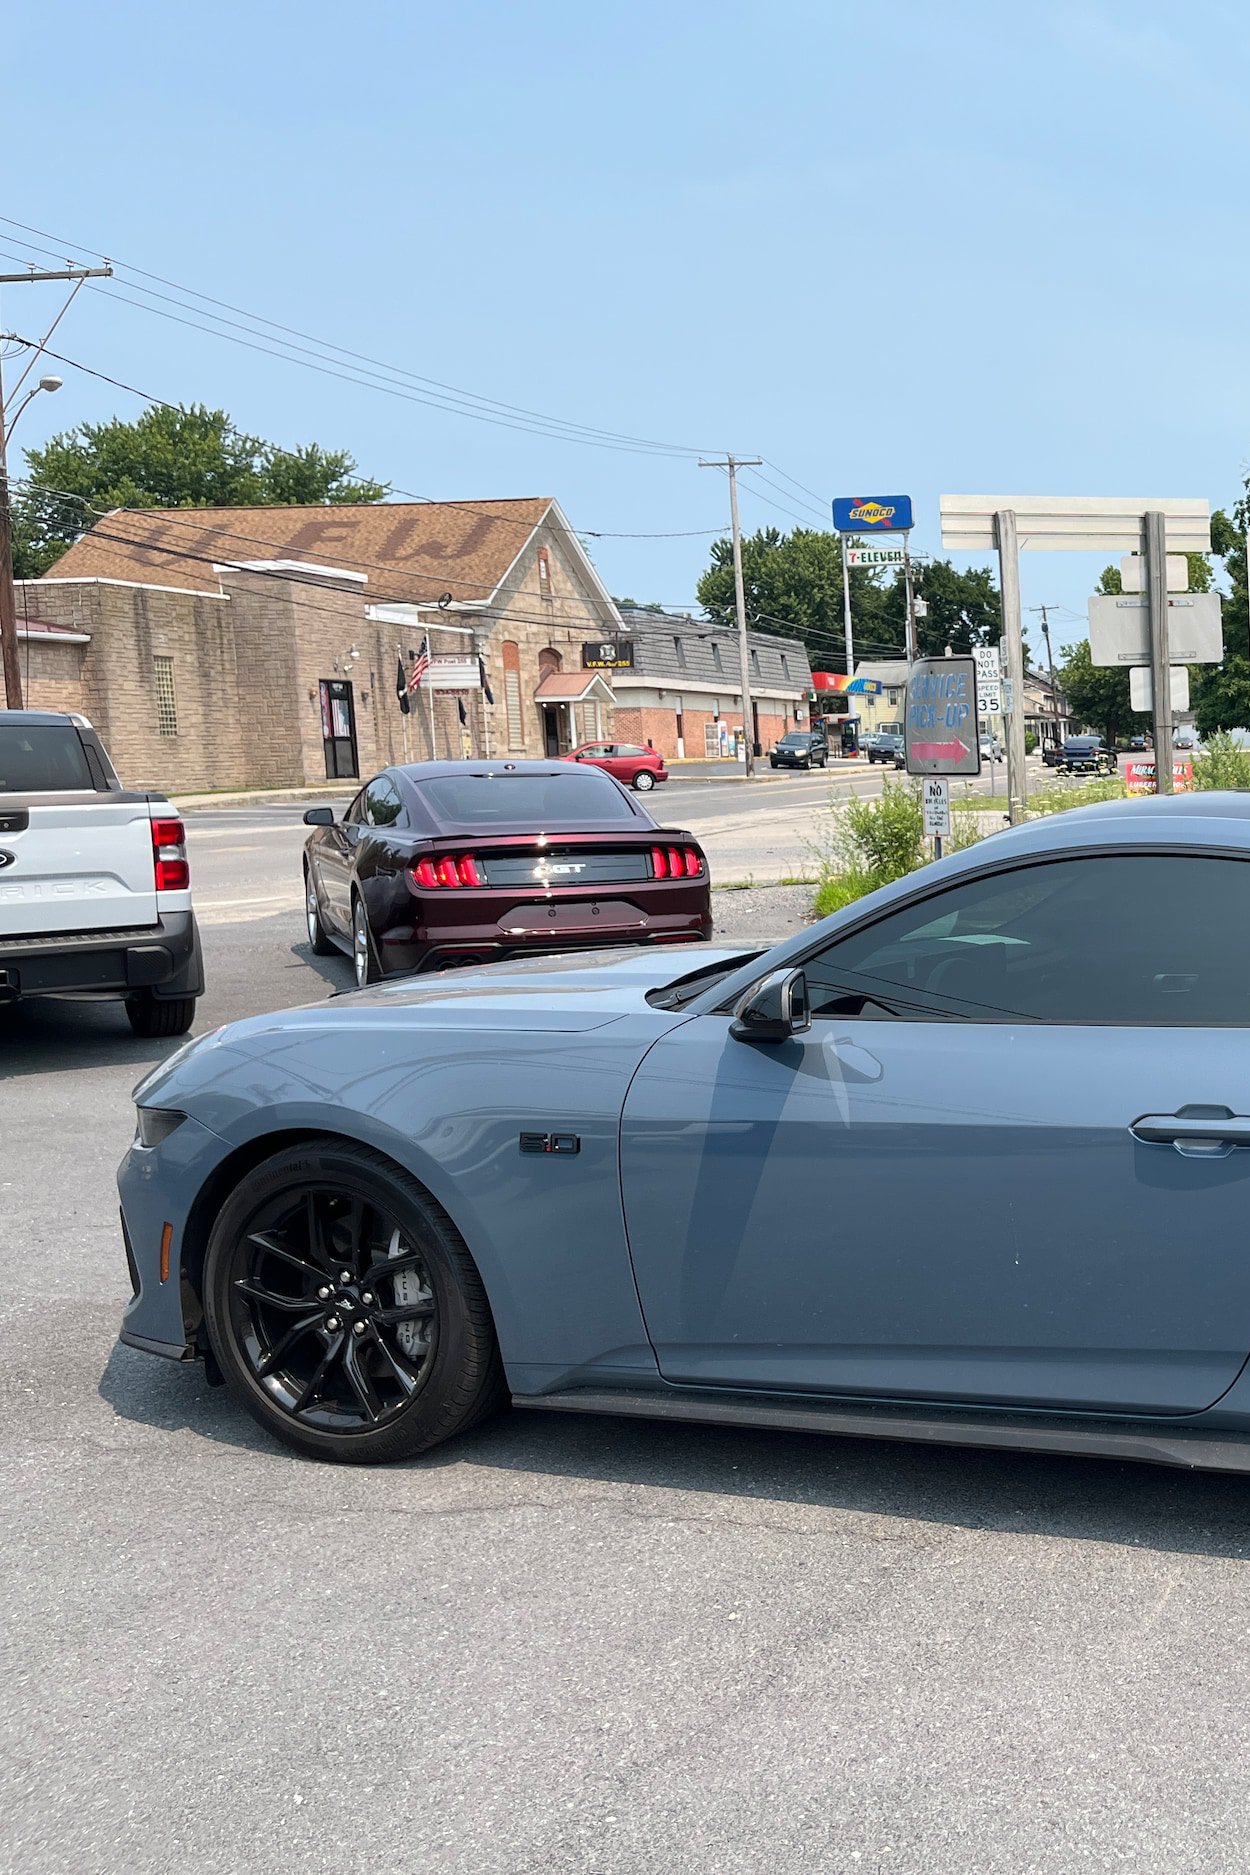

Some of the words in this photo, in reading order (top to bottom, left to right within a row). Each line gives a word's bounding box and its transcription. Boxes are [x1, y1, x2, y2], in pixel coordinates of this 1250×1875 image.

[850, 508, 893, 517] SUNOCO
[979, 650, 992, 659] DO
[977, 660, 995, 668] NOT
[979, 699, 999, 711] 35
[909, 703, 970, 729] PICK-UP
[929, 784, 942, 796] NO
[552, 863, 586, 874] GT
[519, 1132, 581, 1154] 5.0
